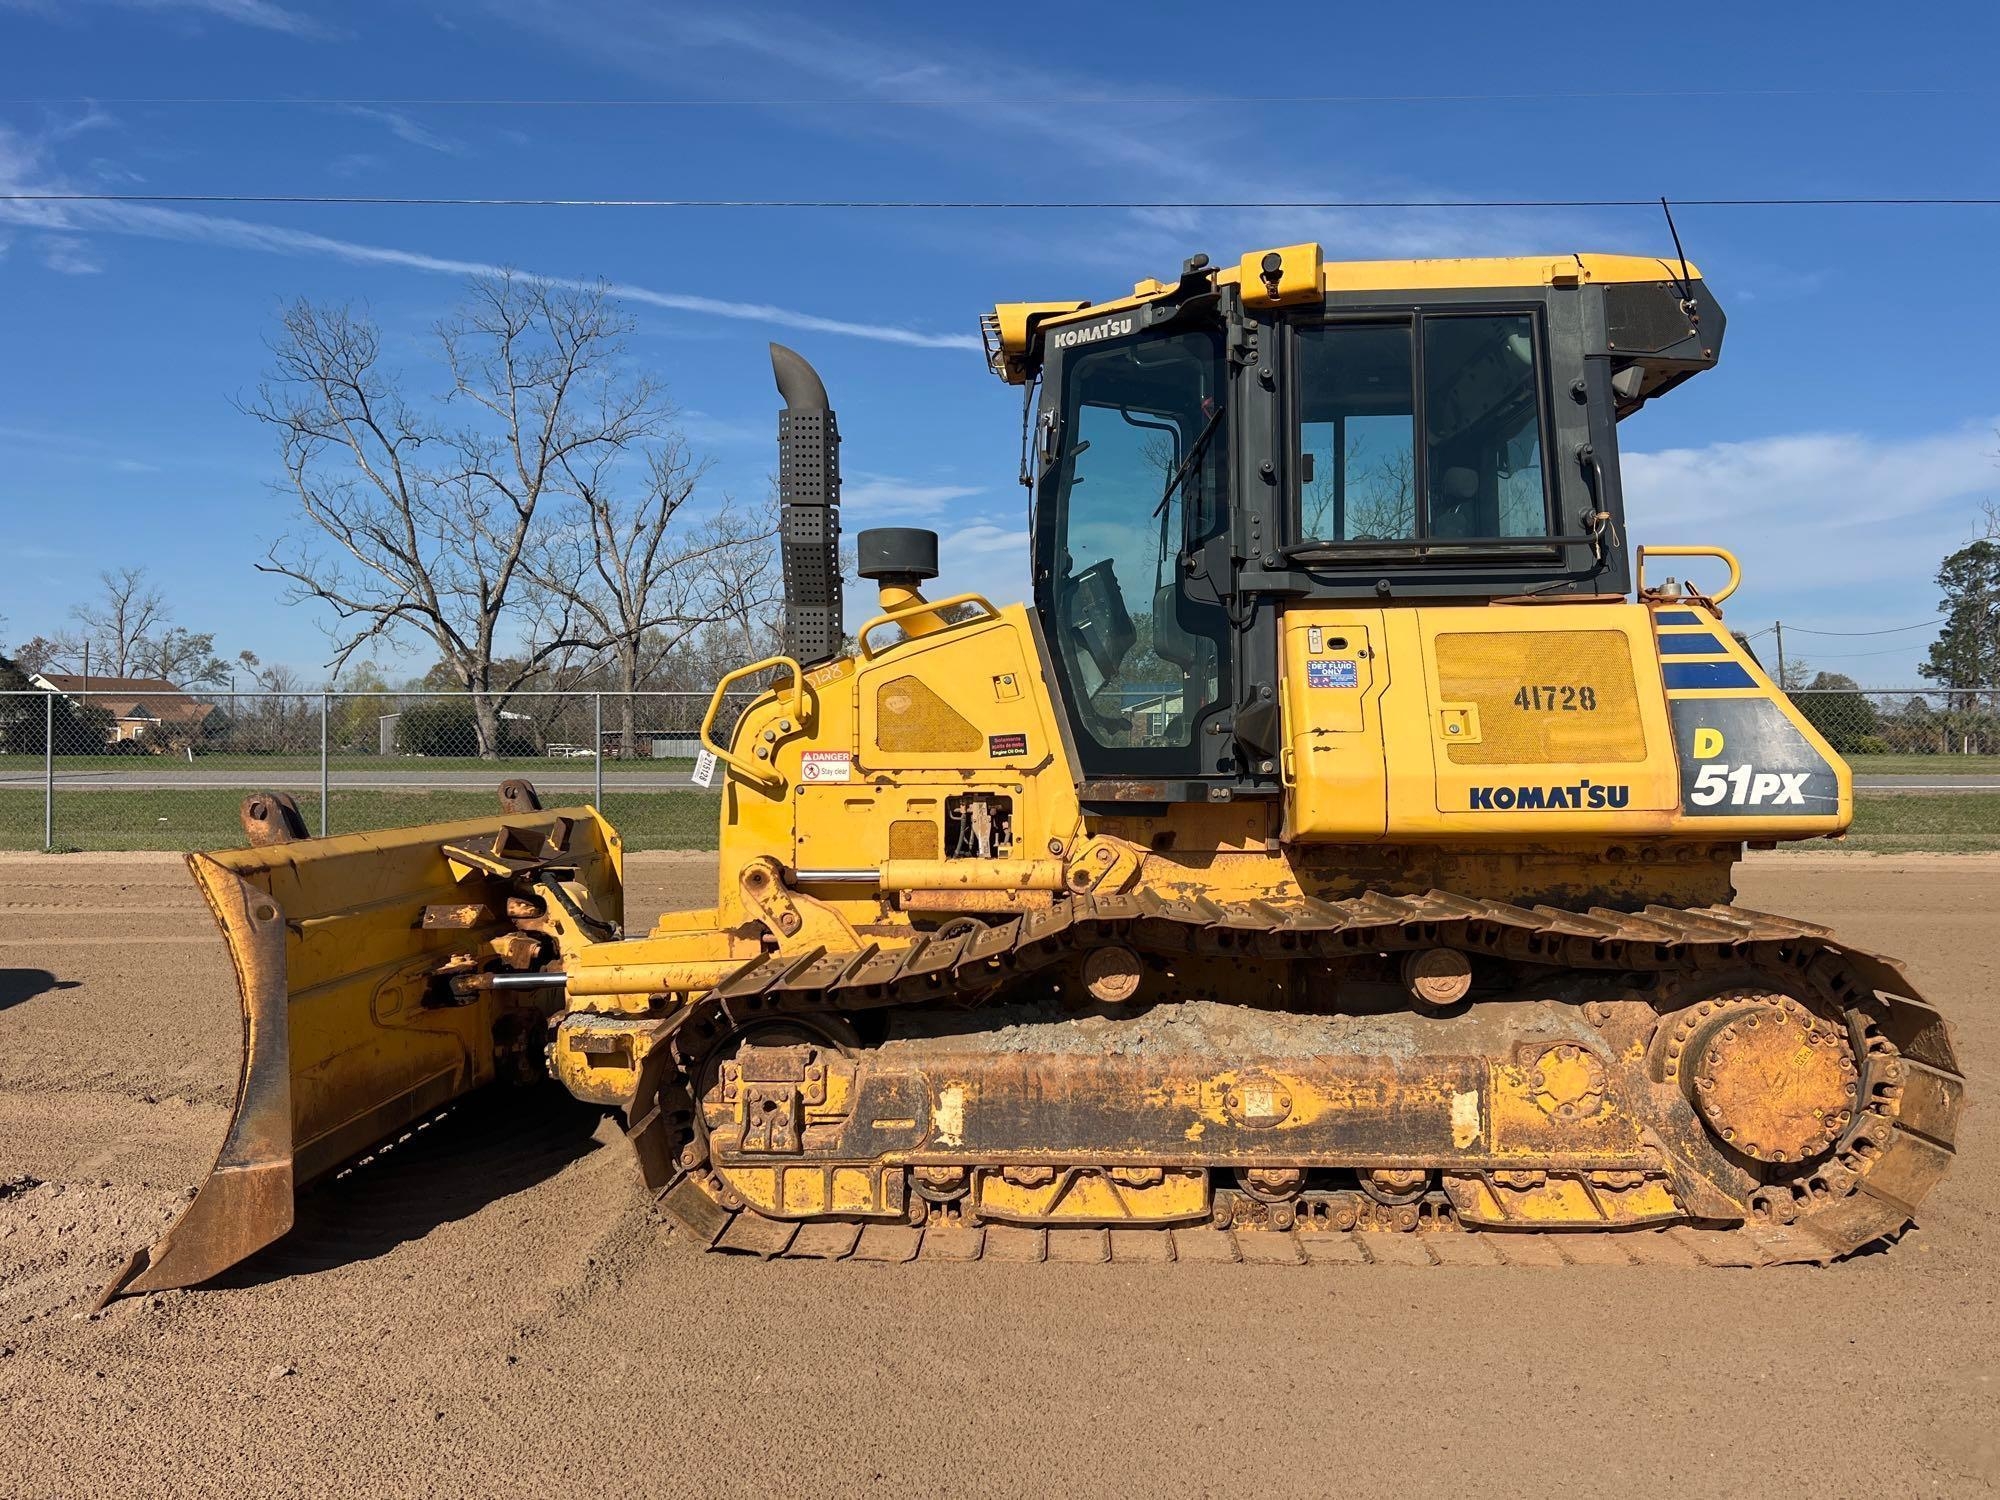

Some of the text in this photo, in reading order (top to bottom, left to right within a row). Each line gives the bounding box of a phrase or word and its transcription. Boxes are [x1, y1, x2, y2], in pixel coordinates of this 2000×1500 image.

[1055, 319, 1131, 348] KOMATSU
[1514, 685, 1597, 711] 41728
[812, 753, 850, 761] DANGER
[821, 767, 833, 776] Stay
[1691, 764, 1811, 806] 51PX
[1469, 779, 1629, 810] KOMATSU
